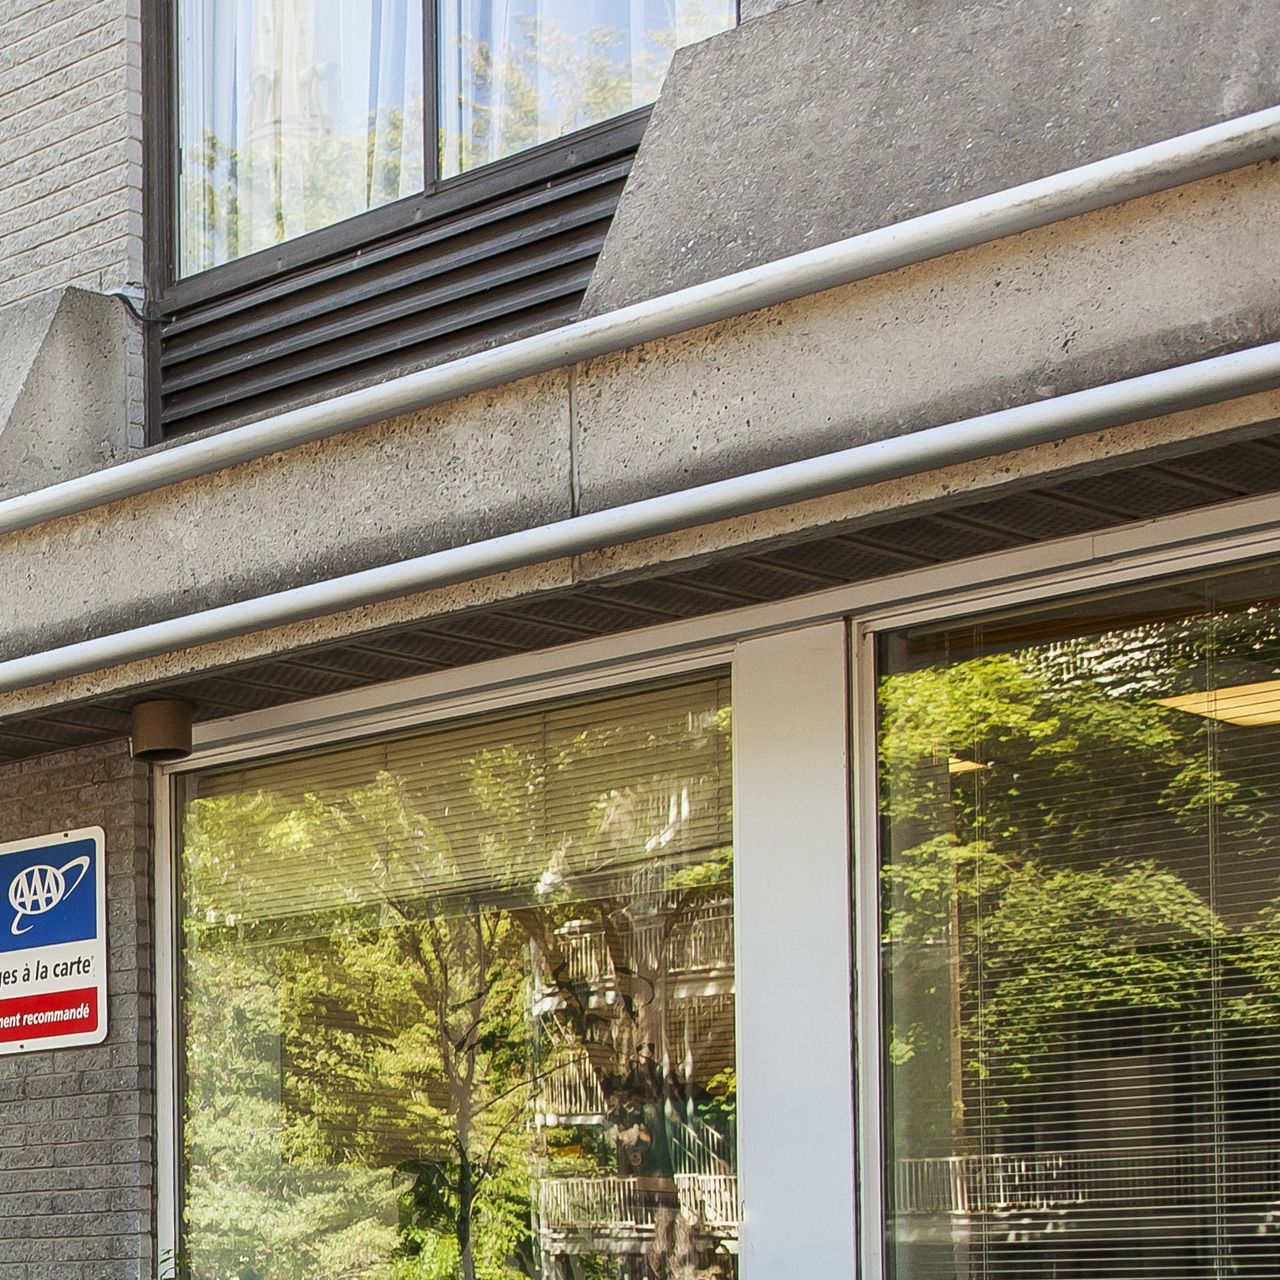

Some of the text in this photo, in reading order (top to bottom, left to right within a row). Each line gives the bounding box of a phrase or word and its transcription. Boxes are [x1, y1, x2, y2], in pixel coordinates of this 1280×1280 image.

[15, 867, 60, 913] AAA
[22, 963, 30, 983] à
[35, 959, 48, 981] la
[53, 955, 91, 978] carte
[22, 1003, 90, 1027] recommandé
